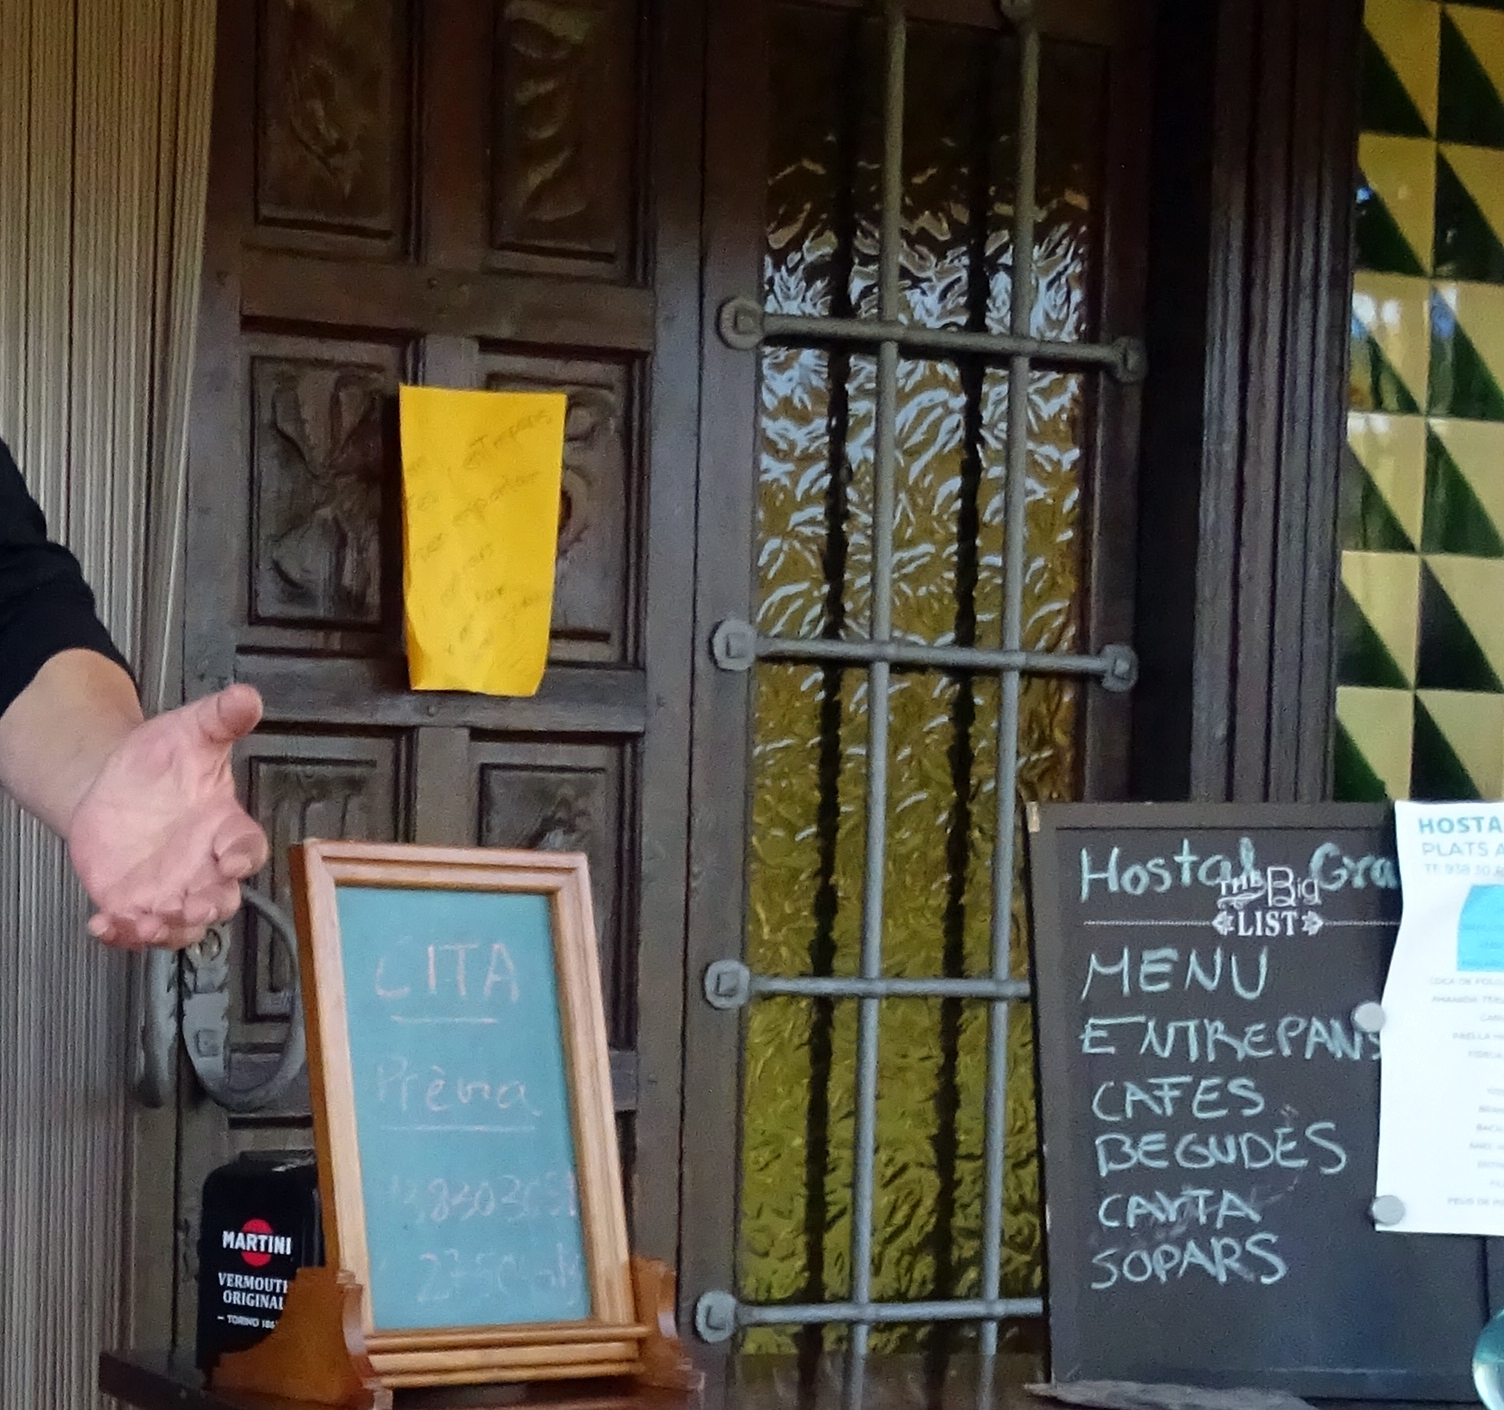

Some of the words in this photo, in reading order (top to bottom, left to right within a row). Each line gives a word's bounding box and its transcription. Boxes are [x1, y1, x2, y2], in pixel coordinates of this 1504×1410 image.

[1080, 837, 1256, 902] Hostal
[1422, 842, 1489, 857] PLATS
[1237, 910, 1298, 937] LIST
[1081, 947, 1269, 1001] MENU
[1092, 1076, 1265, 1121] CAFES
[1096, 1122, 1346, 1177] BEGUDES
[222, 1230, 292, 1256] MARTINI
[1091, 1232, 1288, 1289] SOPARS
